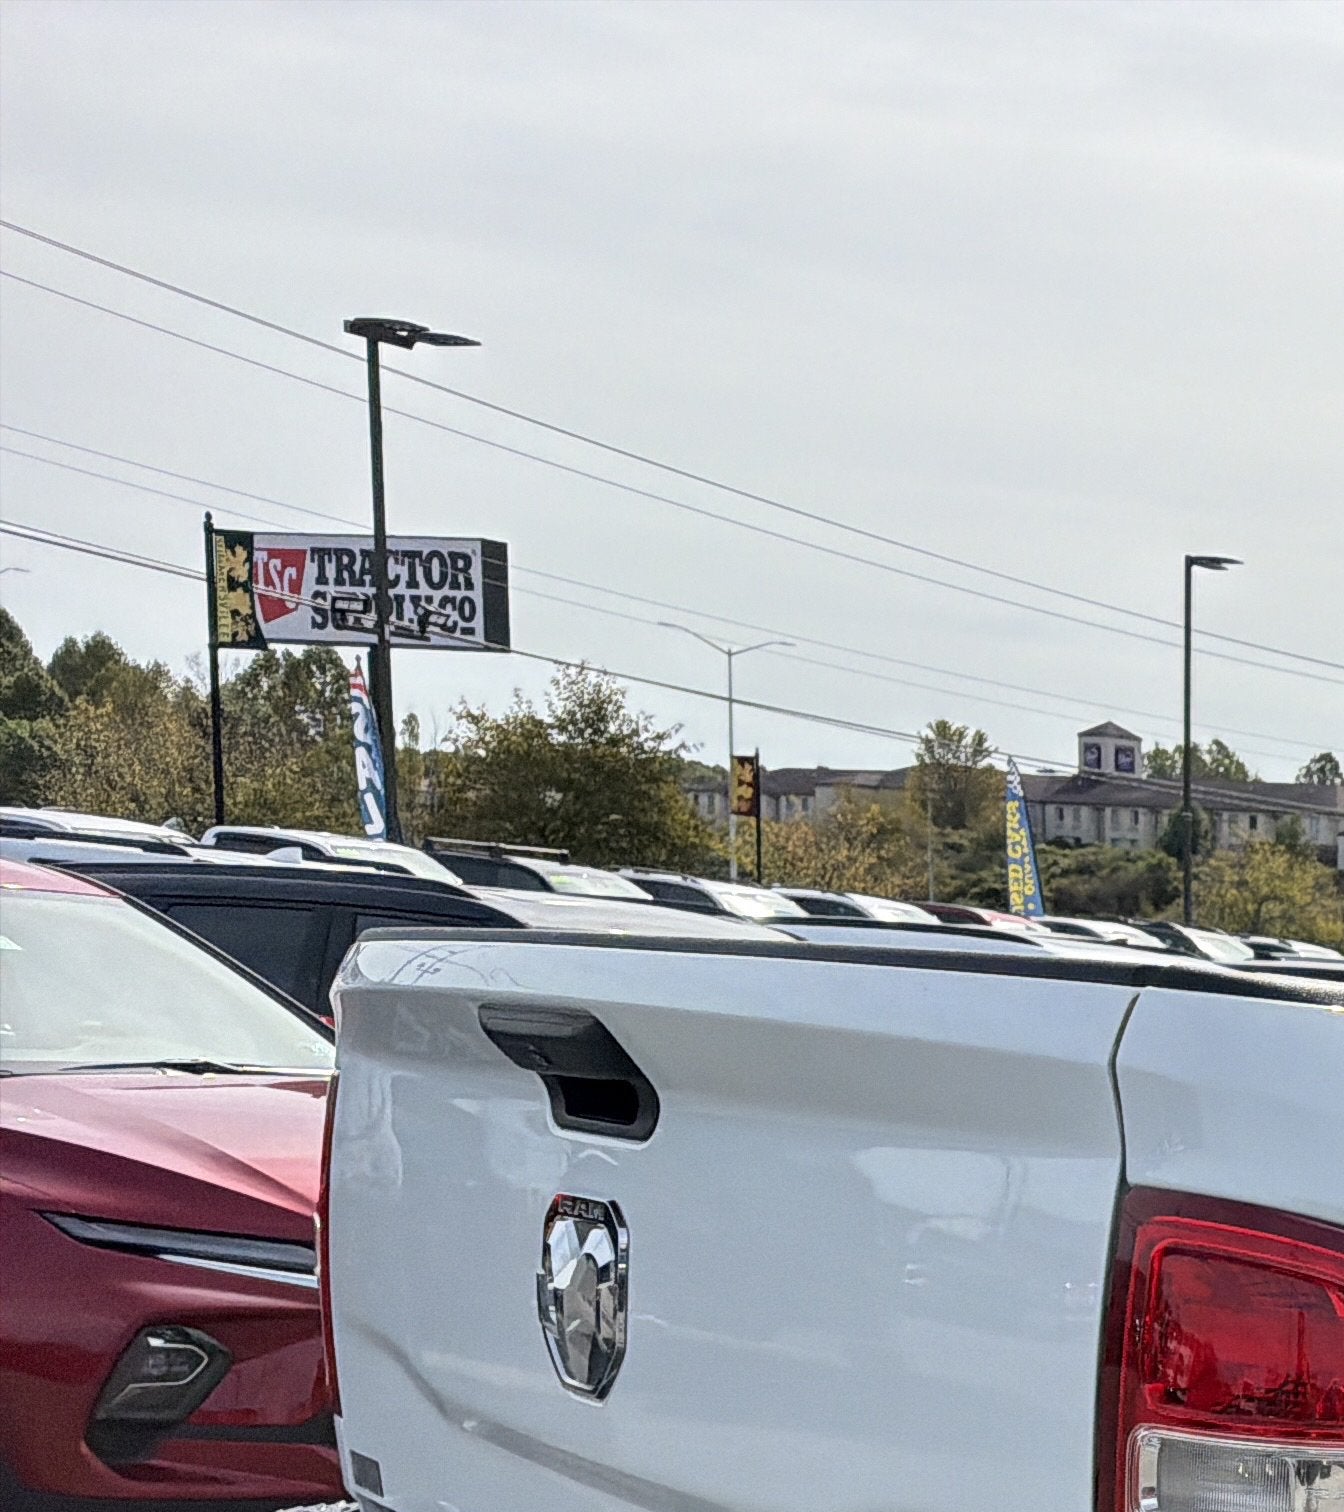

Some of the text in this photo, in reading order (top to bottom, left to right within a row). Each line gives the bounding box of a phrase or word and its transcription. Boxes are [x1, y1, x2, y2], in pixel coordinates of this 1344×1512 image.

[254, 551, 297, 609] TSC
[310, 547, 475, 592] TRACTOR
[558, 1199, 606, 1221] RAM
